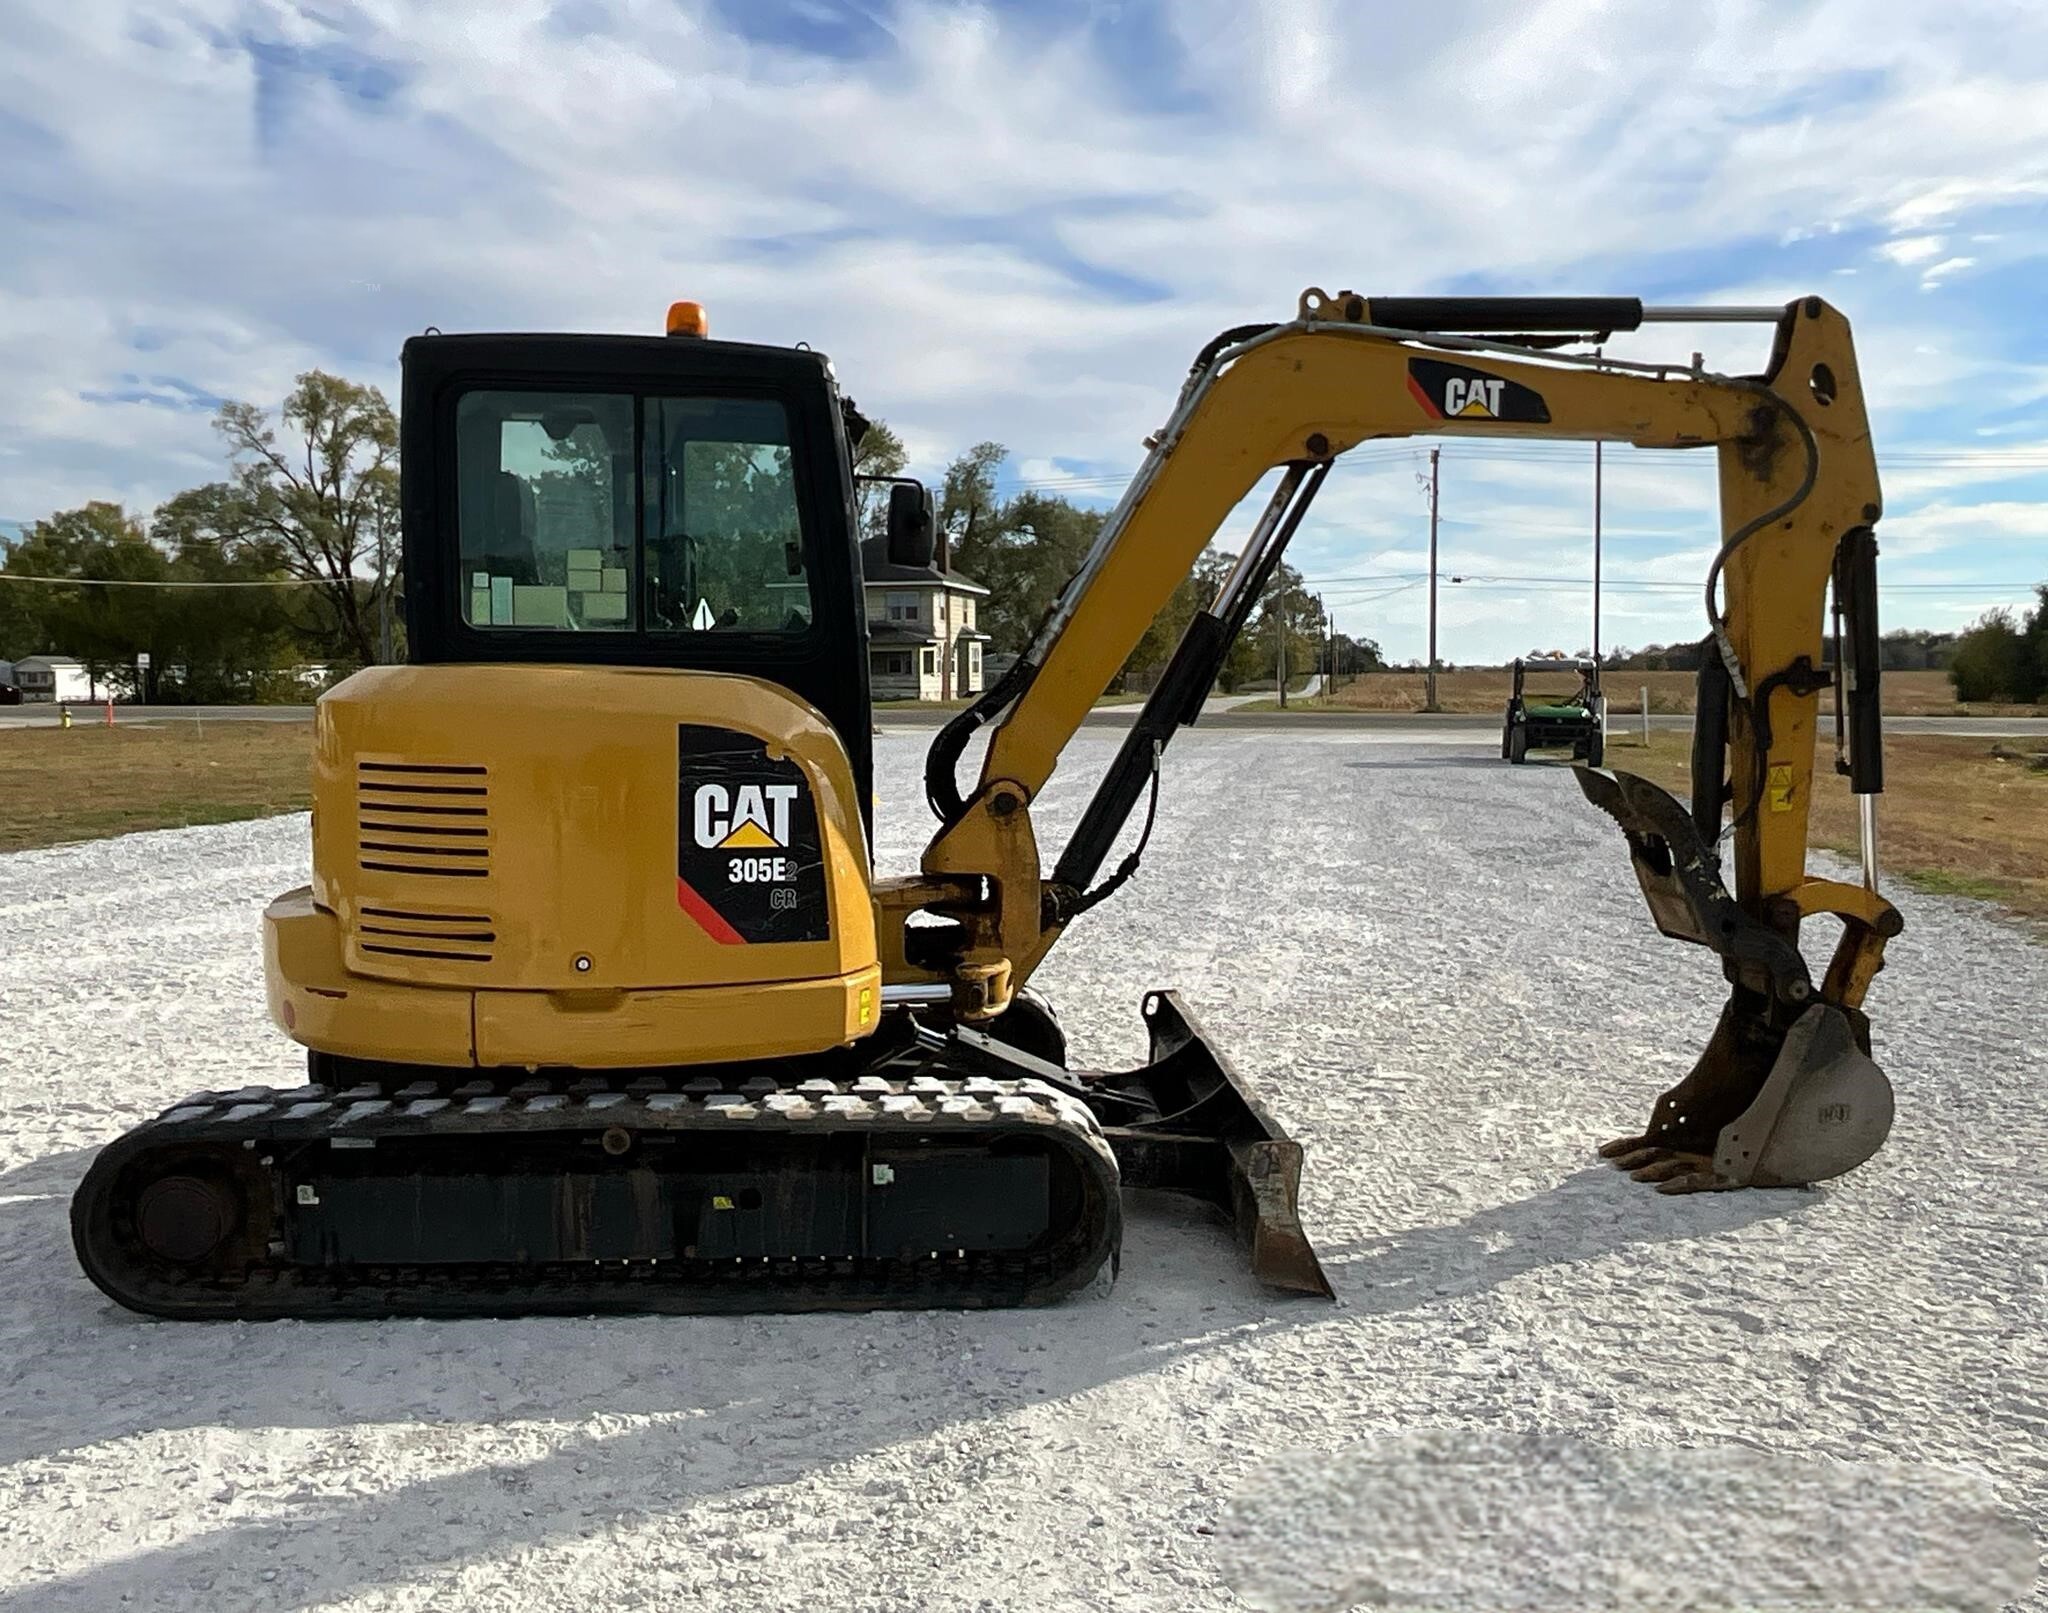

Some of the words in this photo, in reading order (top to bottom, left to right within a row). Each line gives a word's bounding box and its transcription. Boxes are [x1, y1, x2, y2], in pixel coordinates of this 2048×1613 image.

[1445, 377, 1505, 417] CAT
[694, 784, 798, 848] CAT
[729, 857, 798, 883] 305E2
[770, 888, 797, 909] CR
